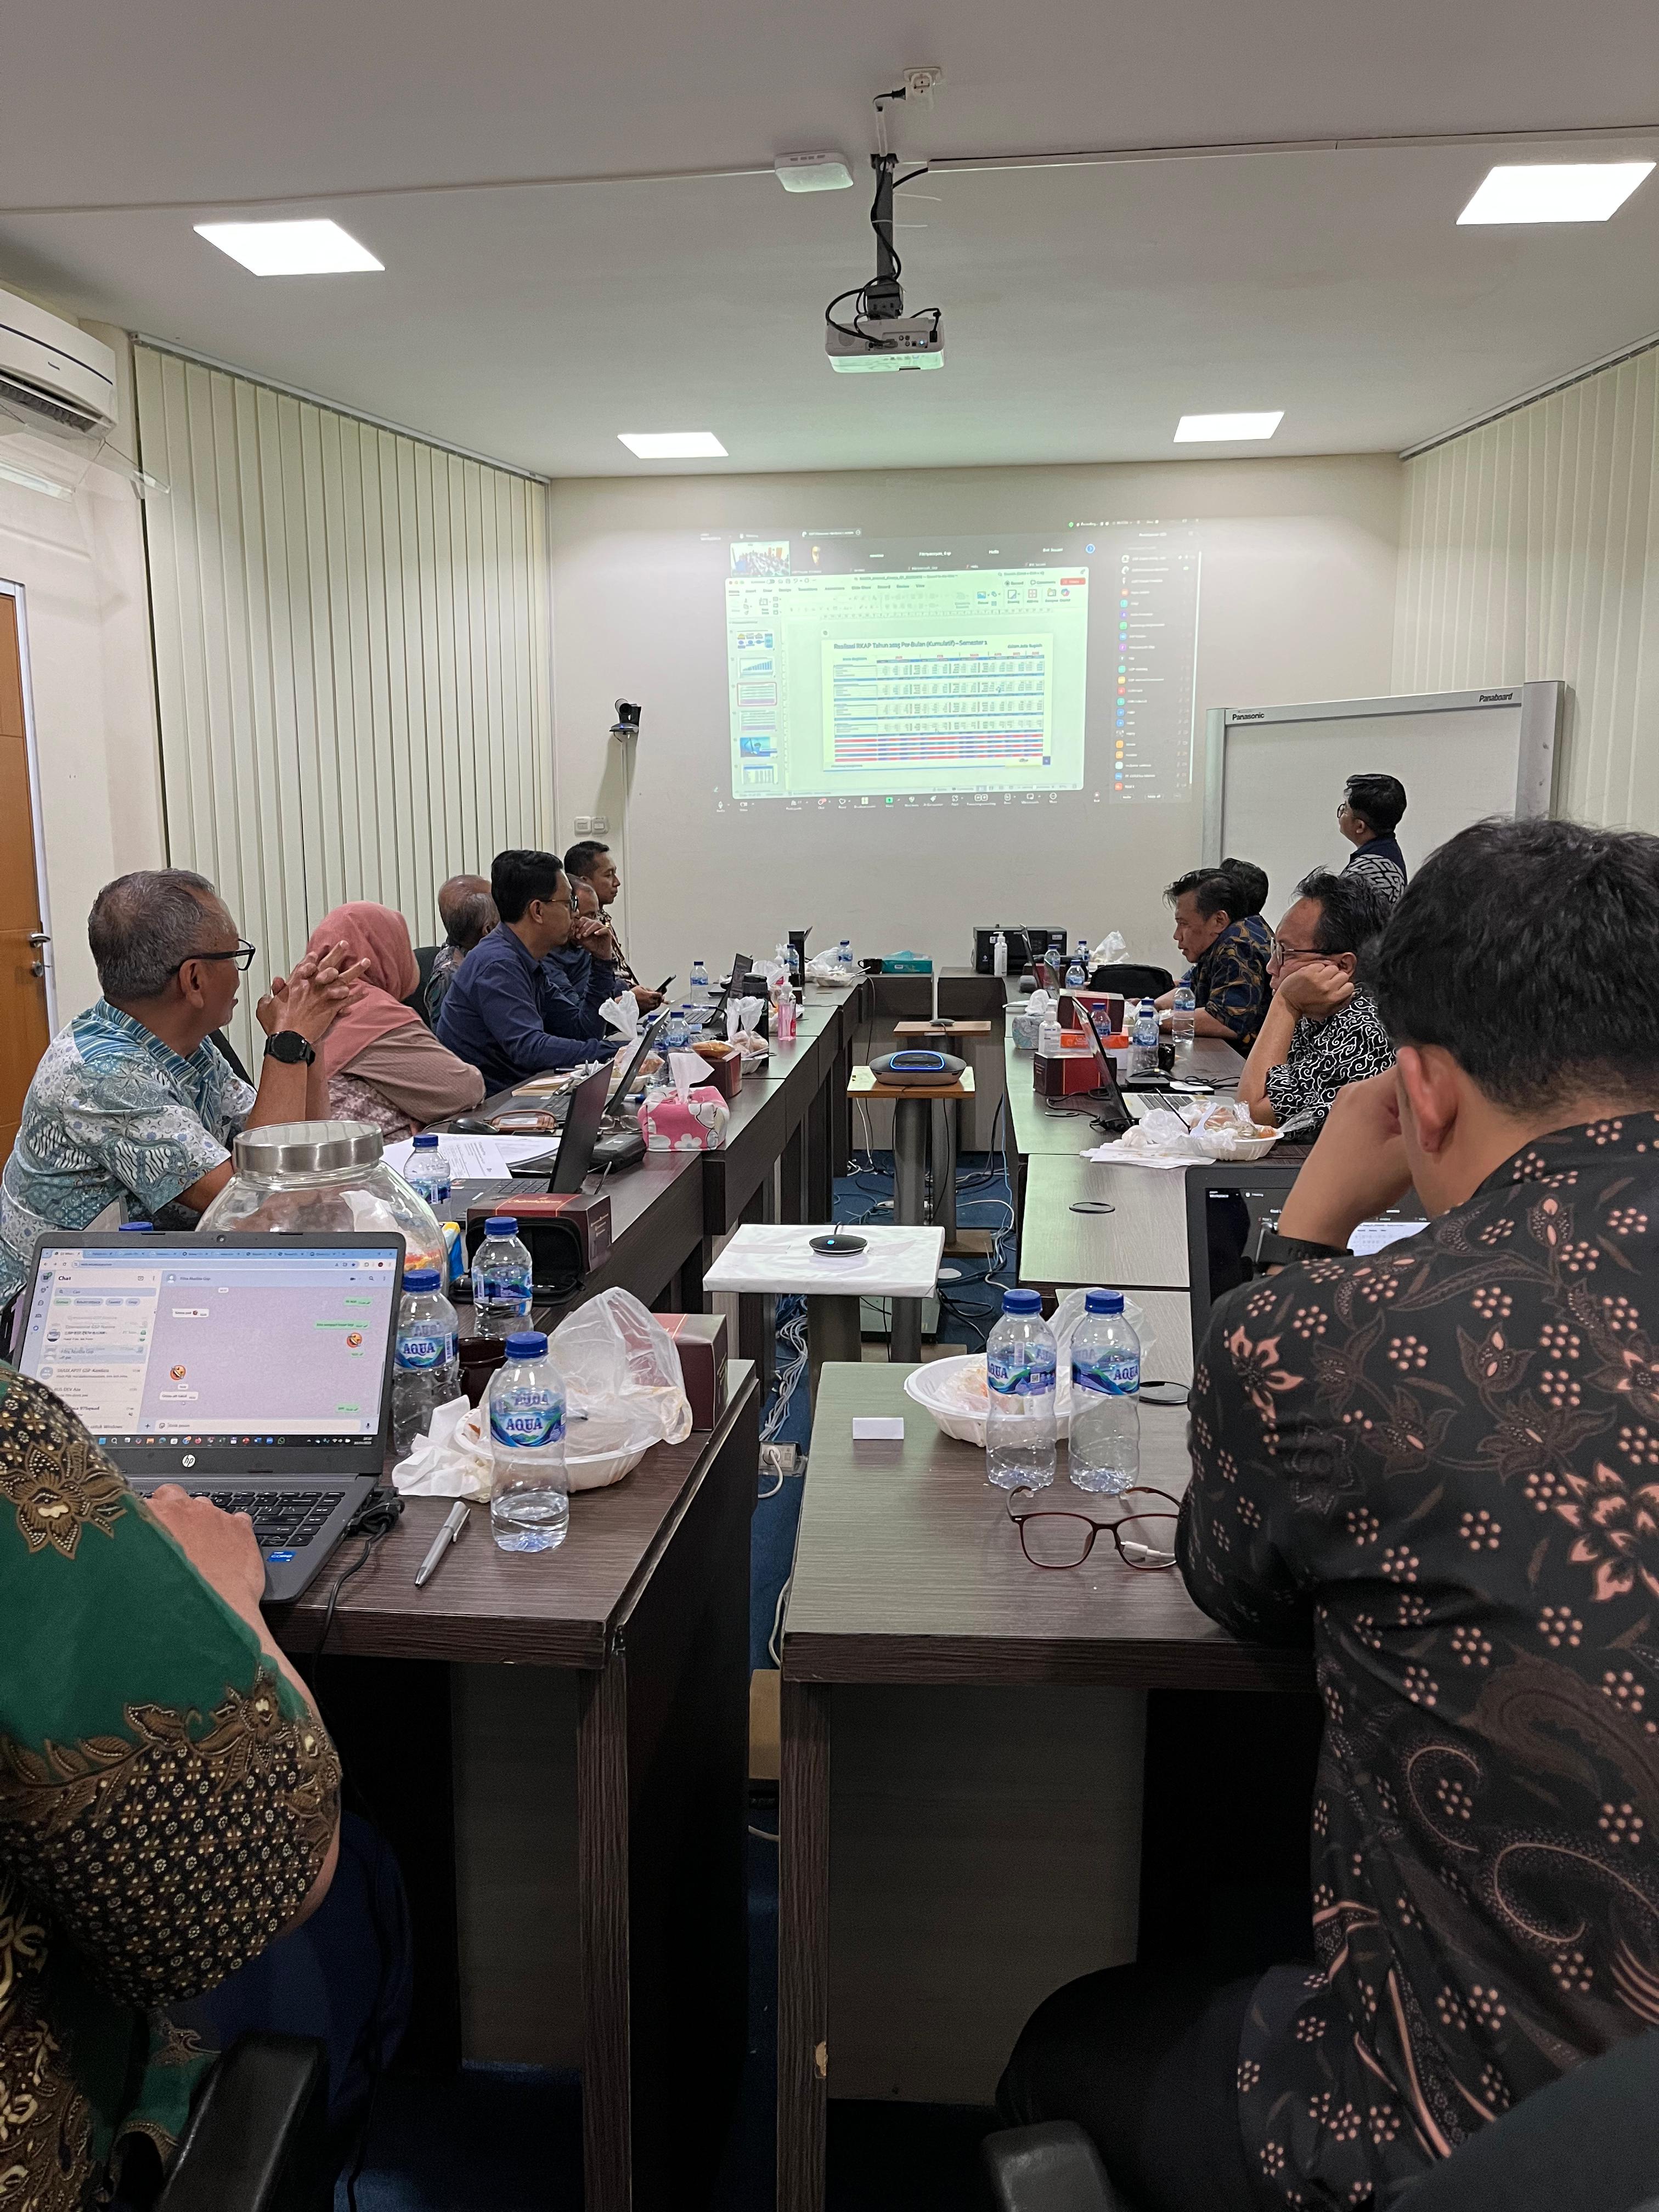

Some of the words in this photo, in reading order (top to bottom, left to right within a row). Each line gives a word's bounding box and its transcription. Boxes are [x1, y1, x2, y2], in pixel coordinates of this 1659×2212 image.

[1479, 692, 1513, 702] Panaboard
[1232, 712, 1265, 720] Panasonic
[403, 1342, 436, 1356] AQUA
[506, 1418, 543, 1433] AQUA
[183, 1454, 195, 1468] hp
